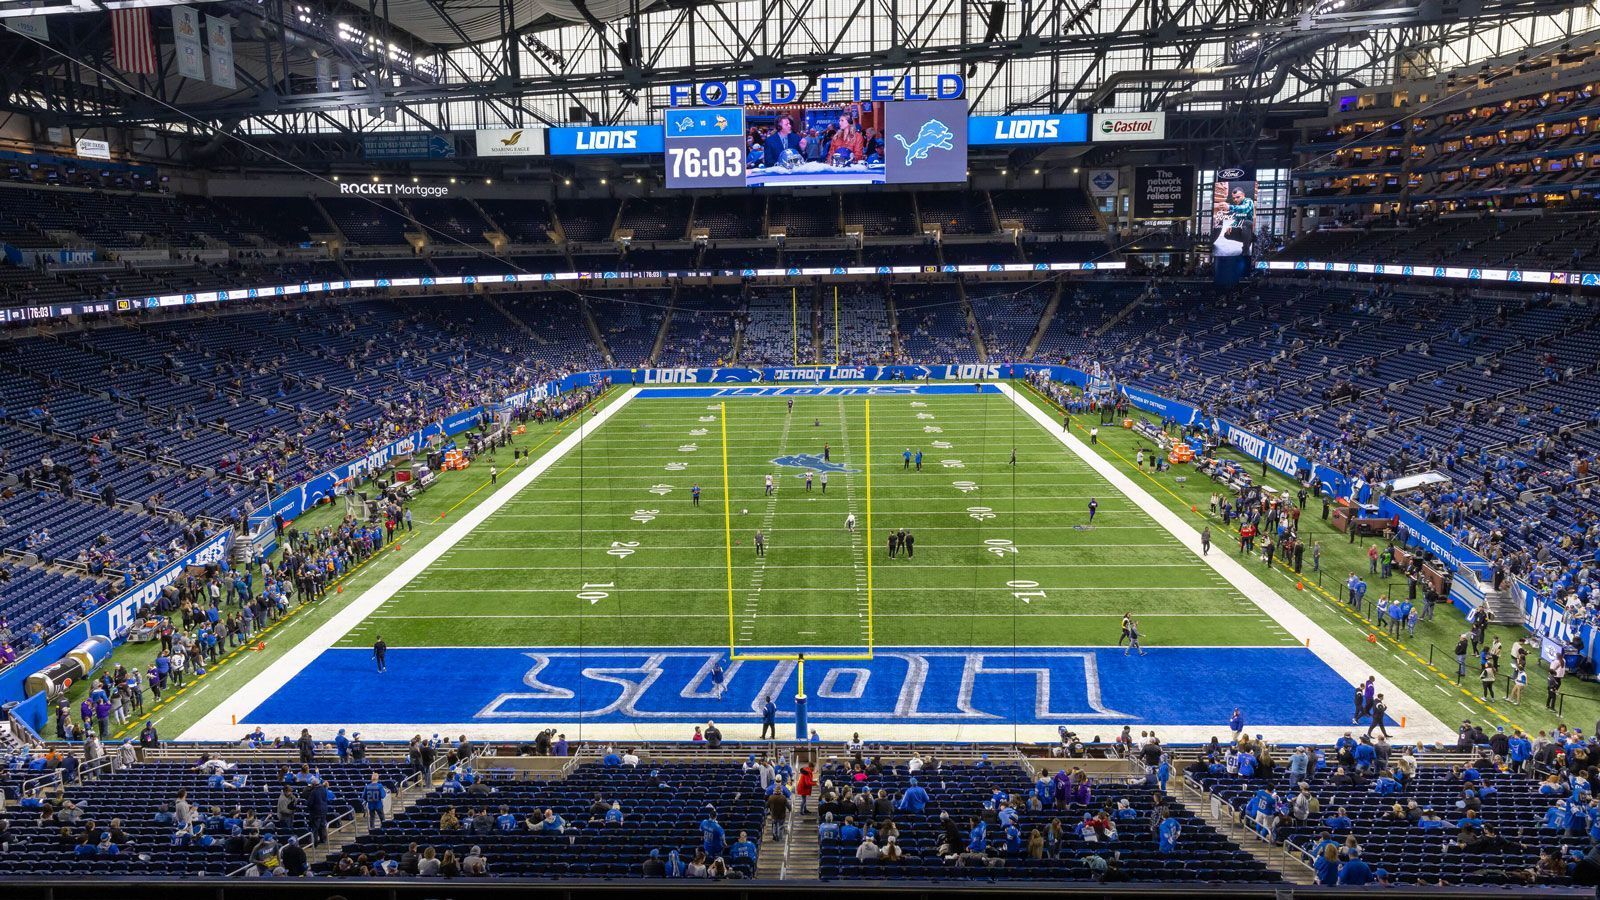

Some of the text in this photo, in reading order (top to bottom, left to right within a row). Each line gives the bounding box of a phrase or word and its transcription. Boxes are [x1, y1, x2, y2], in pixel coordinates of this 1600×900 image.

[670, 74, 965, 107] FORD FIELD
[994, 119, 1060, 140] LIONS
[1113, 120, 1153, 133] Castrol
[576, 130, 637, 151] LIONS
[668, 147, 742, 178] 76:03
[1157, 170, 1173, 178] The
[340, 183, 449, 198] ROCKET Mortgage
[1147, 185, 1181, 193] America
[66, 251, 94, 263] LIONS
[20, 308, 26, 319] 1
[30, 306, 49, 319] 76:03
[644, 368, 699, 384] LIONS
[774, 366, 865, 380] DETROIT LIONS
[944, 364, 1001, 380] LIONS
[347, 435, 415, 479] DETROIT LIONS
[1227, 425, 1300, 477] DETROIT LIONS
[630, 509, 660, 521] 30
[966, 507, 997, 519] 30
[607, 541, 640, 554] 20
[984, 539, 1019, 554] 20
[1421, 533, 1431, 547] BY
[1430, 542, 1460, 568] DETROIT
[576, 581, 615, 599] 10
[1006, 580, 1048, 599] 10
[472, 651, 1142, 720] LIONS
[367, 790, 380, 799] 20
[1258, 798, 1268, 810] 16
